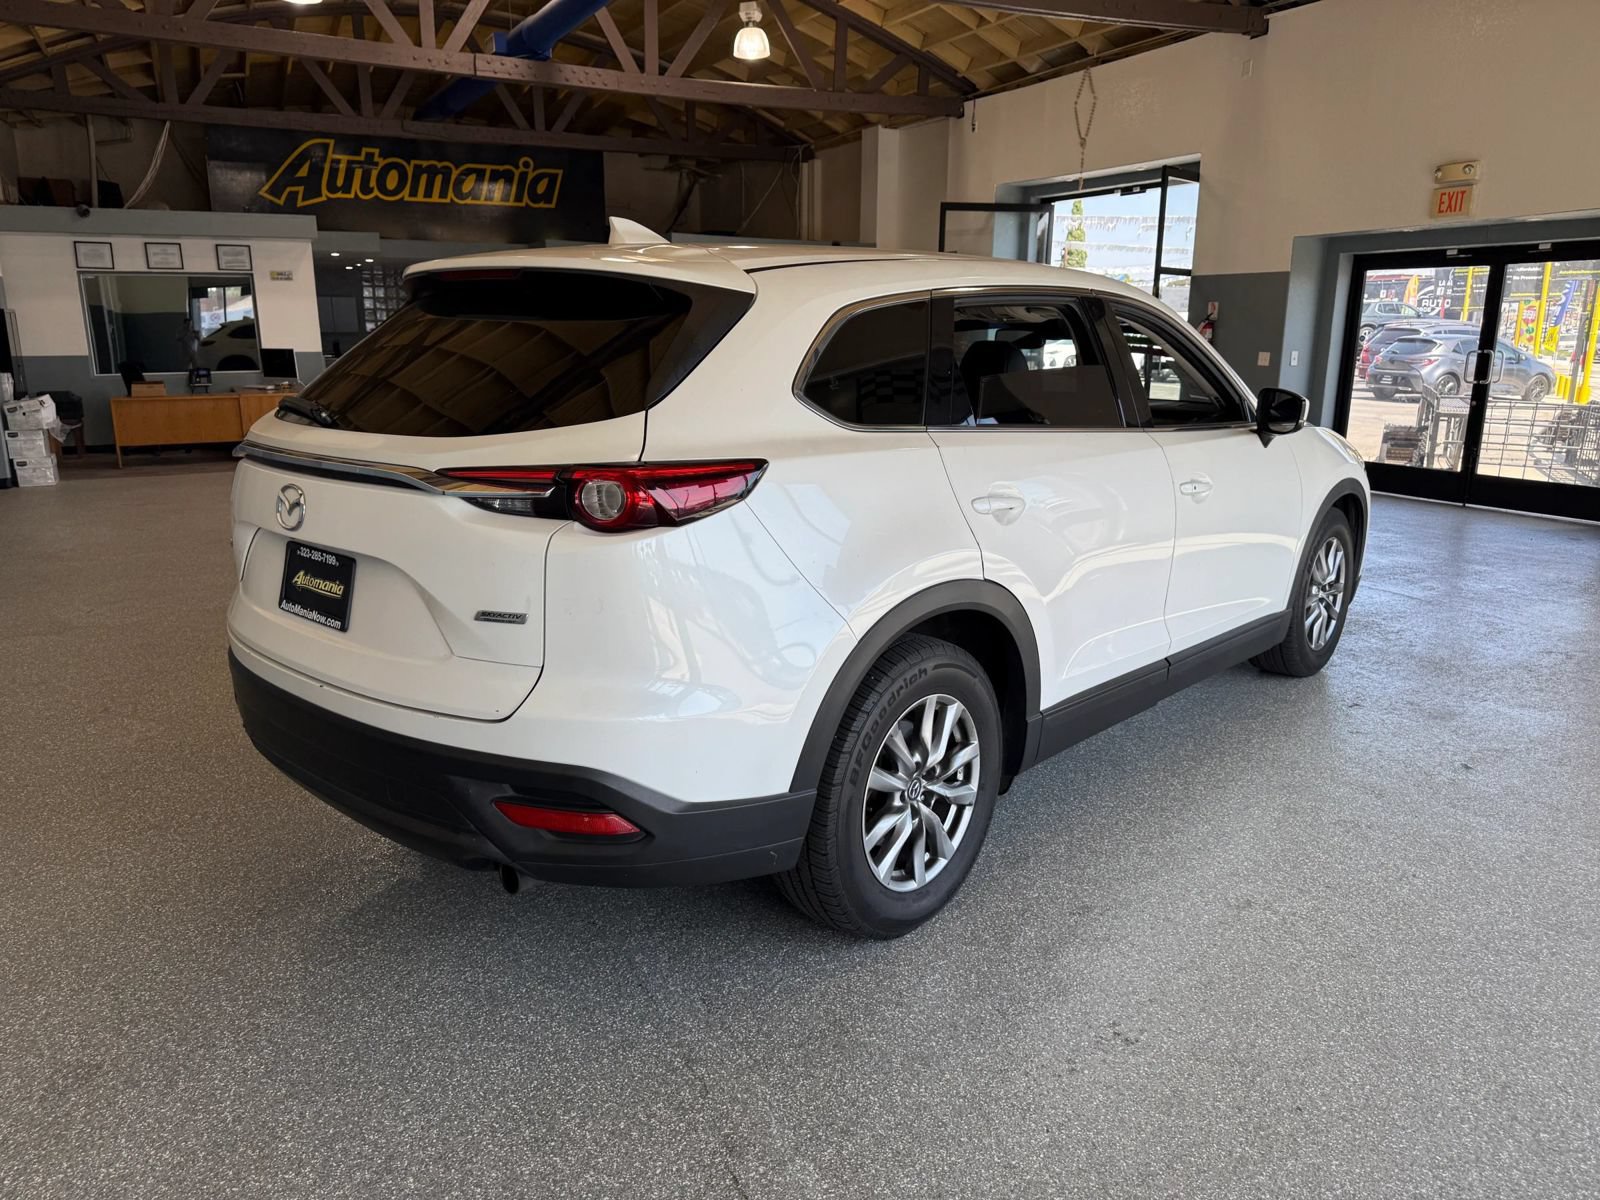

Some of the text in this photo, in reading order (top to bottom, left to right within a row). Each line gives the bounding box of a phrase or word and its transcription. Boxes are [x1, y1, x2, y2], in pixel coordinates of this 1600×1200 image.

[258, 138, 563, 208] Automania
[1437, 190, 1467, 214] EXIT
[292, 569, 344, 595] Automania
[280, 599, 341, 629] AutoManiaNow.com
[481, 611, 522, 619] SKYACTIV
[849, 667, 928, 788] BFGoodrich
